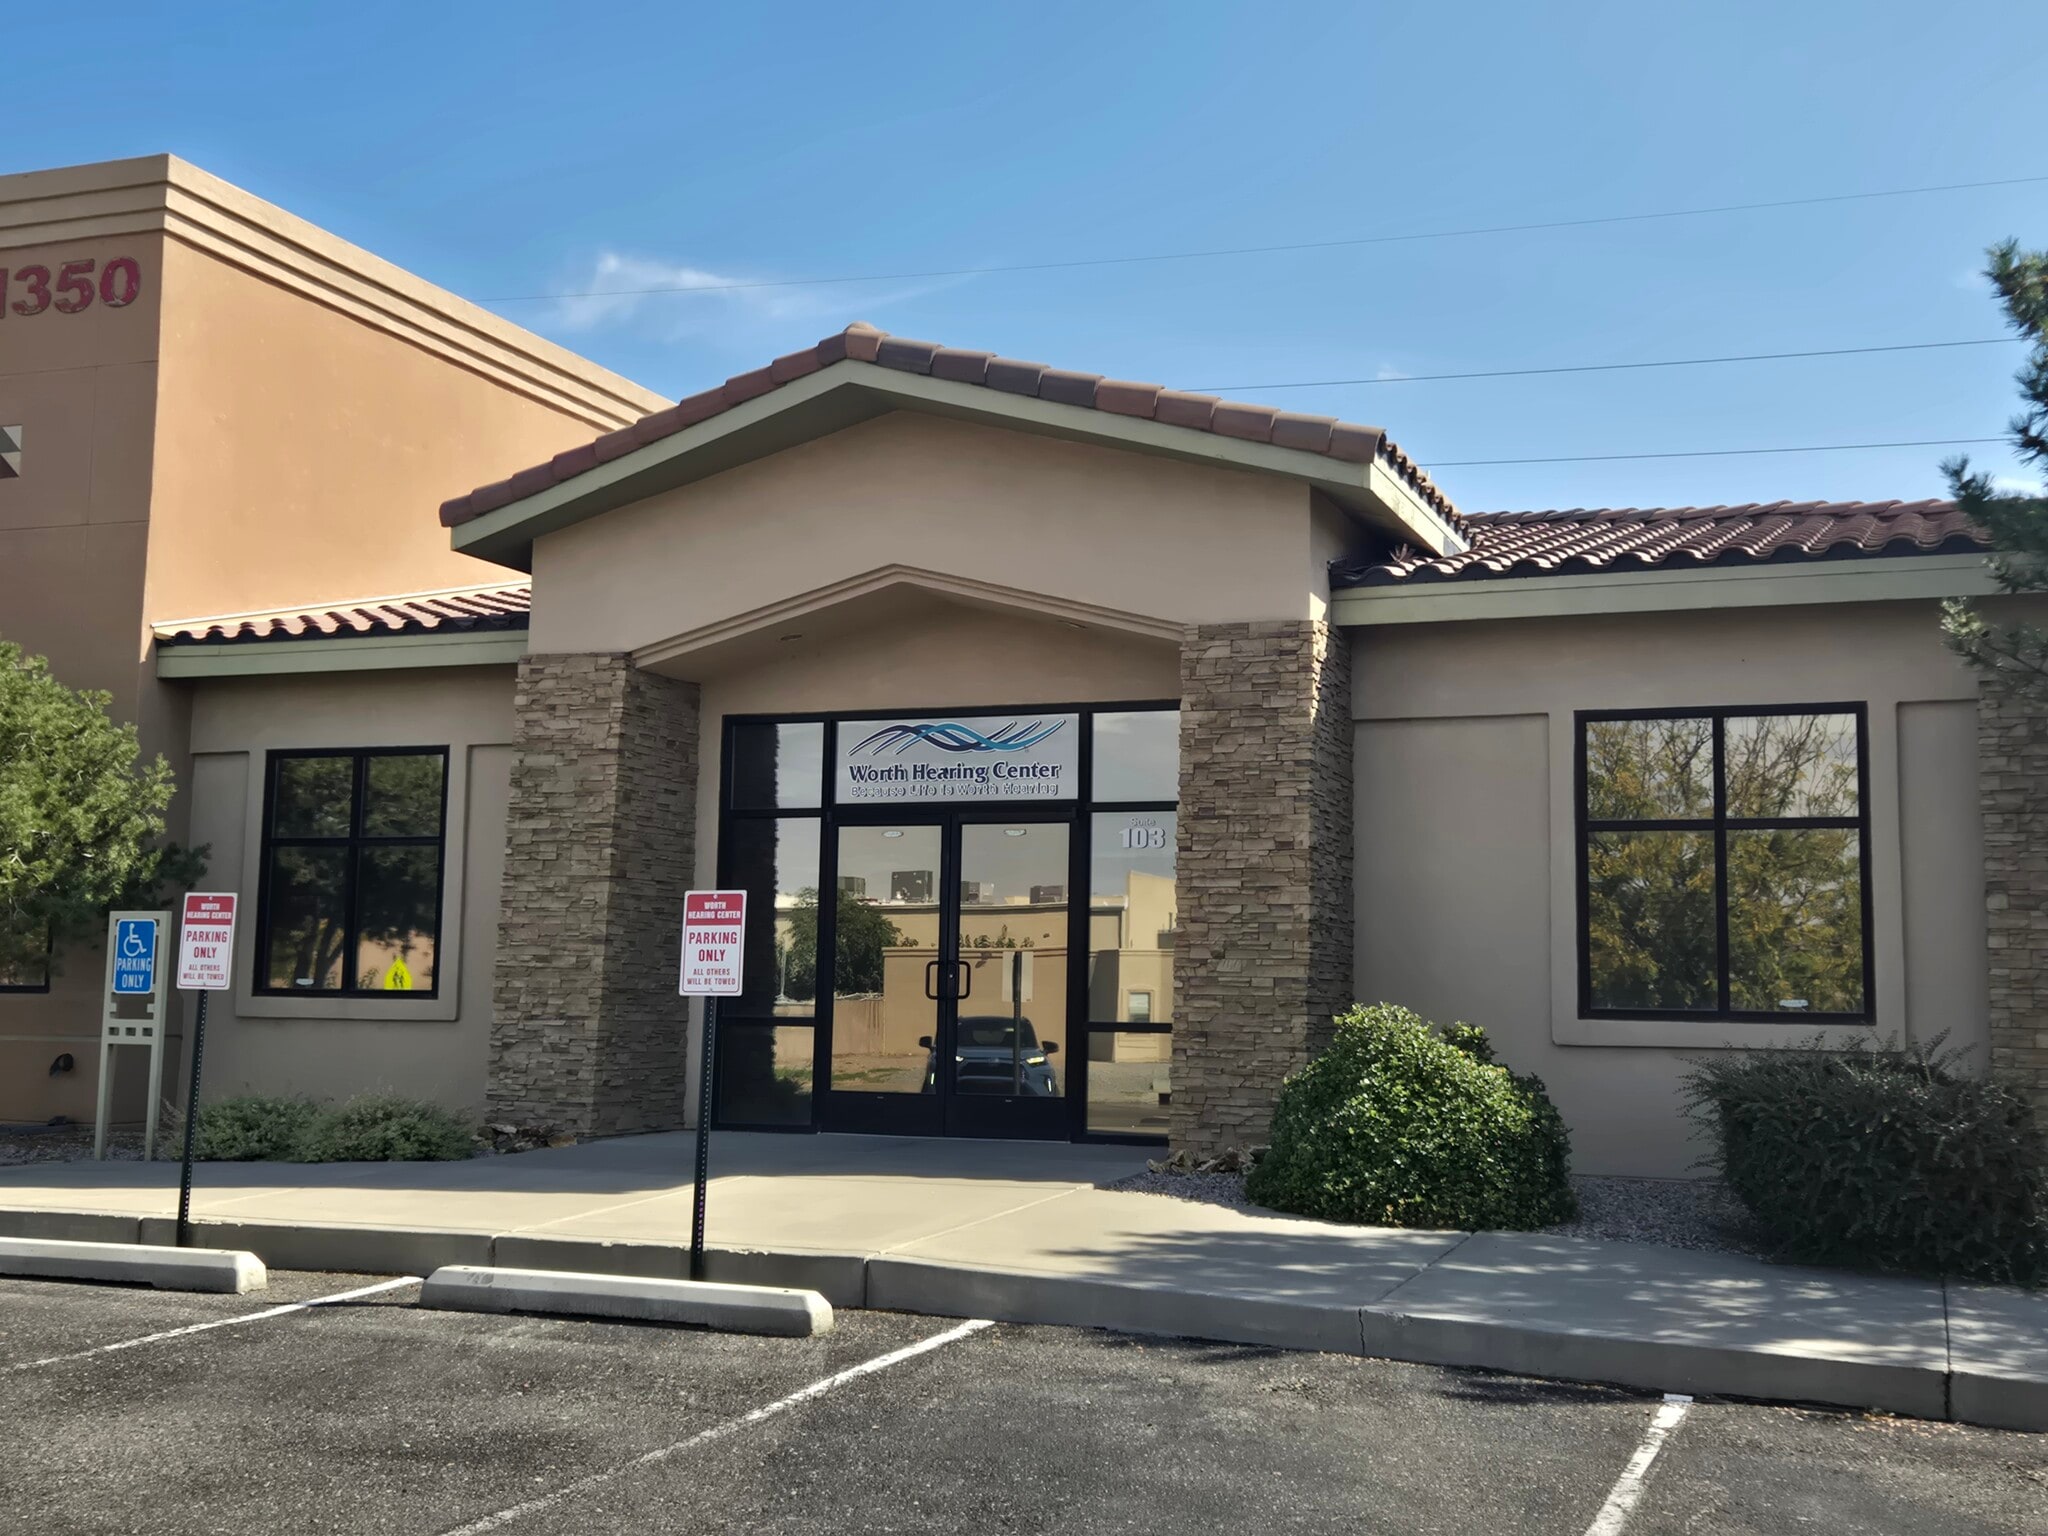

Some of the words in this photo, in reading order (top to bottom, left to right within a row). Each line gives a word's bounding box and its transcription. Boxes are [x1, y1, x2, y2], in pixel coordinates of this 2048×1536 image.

[848, 764, 908, 783] Worth
[911, 762, 989, 784] Hearing
[992, 761, 1062, 780] Center
[850, 784, 906, 797] Because
[909, 784, 937, 796] Life
[956, 783, 998, 795] Worth
[1002, 782, 1059, 796] Hearing
[1119, 827, 1166, 849] 103
[717, 910, 741, 919] CENTER
[186, 931, 228, 943] PARKING
[688, 932, 738, 945] PARKING
[193, 947, 217, 959] ONLY
[698, 949, 726, 962] ONLY
[116, 957, 152, 972] PARKING
[693, 968, 704, 976] ALL
[706, 968, 730, 976] OTHERS
[121, 974, 145, 988] ONLY
